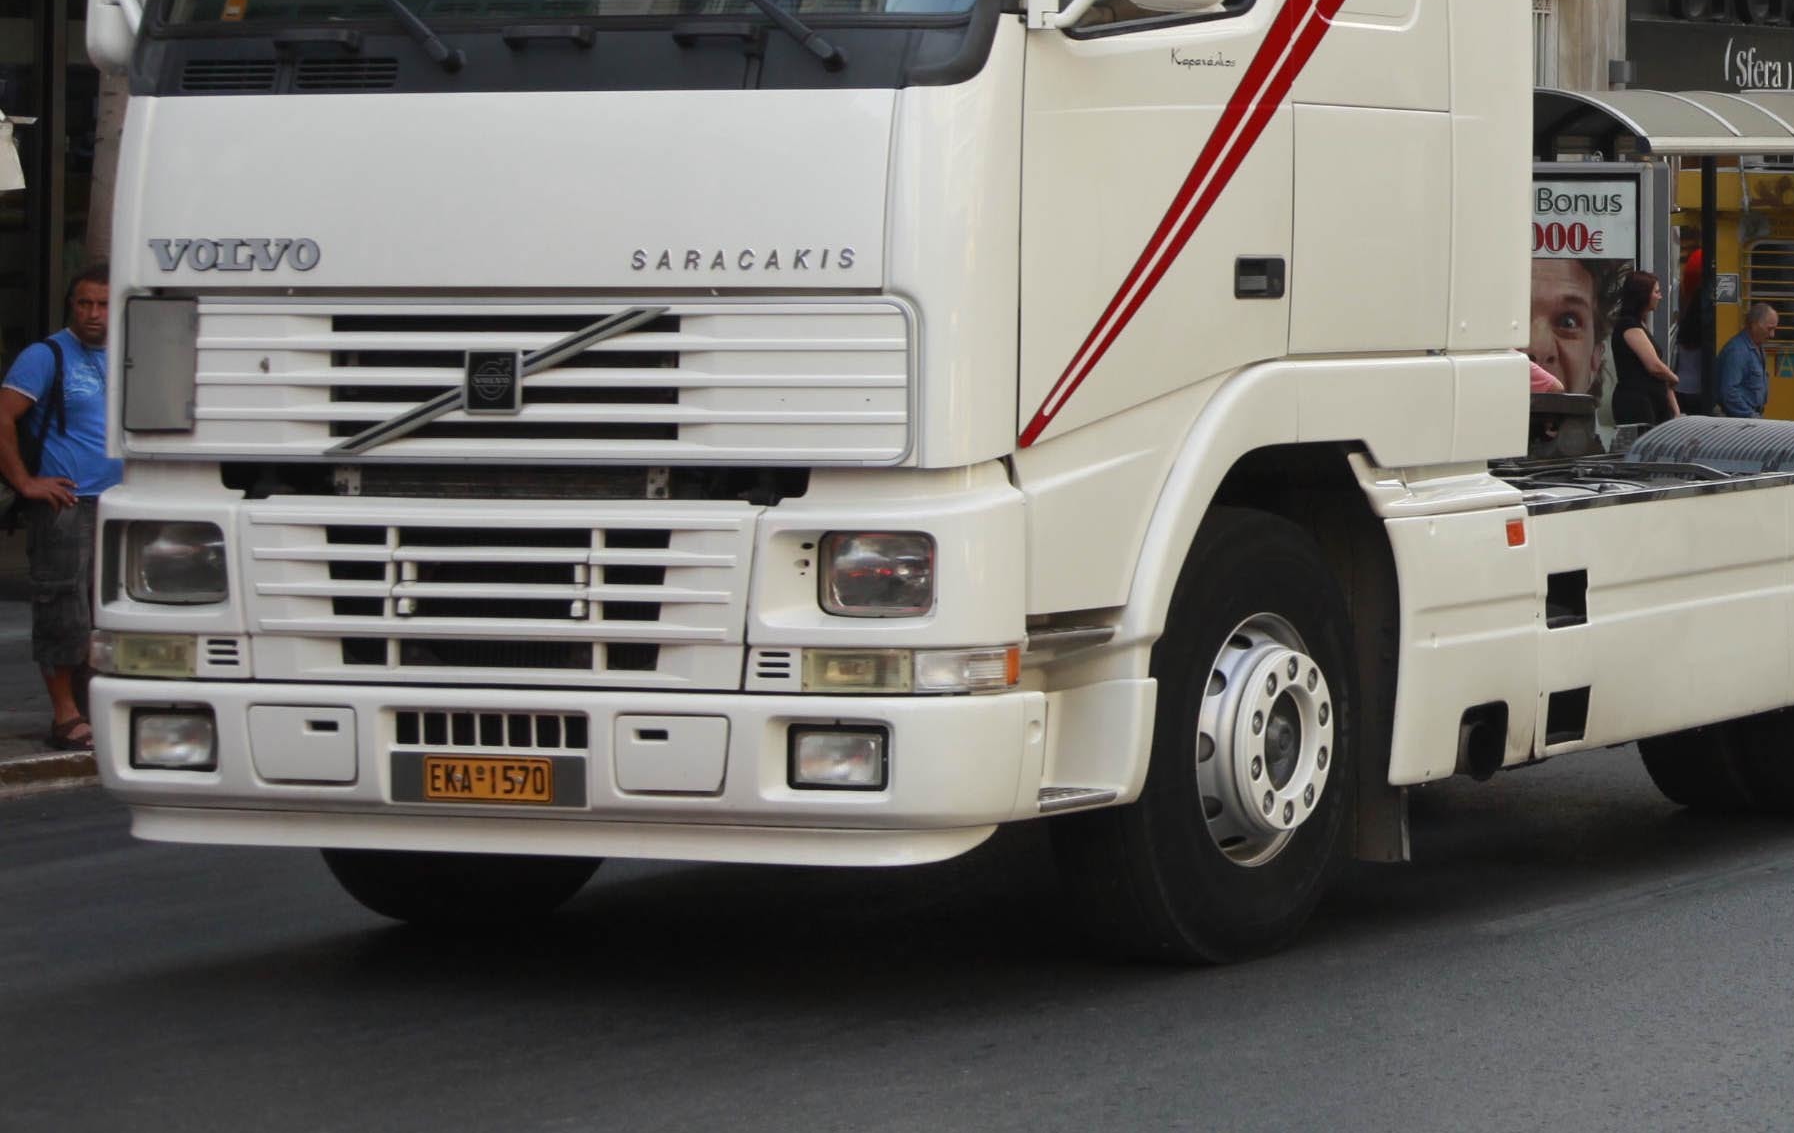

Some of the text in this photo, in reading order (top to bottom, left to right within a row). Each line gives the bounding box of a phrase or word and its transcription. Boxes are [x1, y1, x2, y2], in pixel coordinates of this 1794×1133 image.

[1536, 187, 1623, 214] Bonus
[148, 238, 321, 272] VOLVO
[630, 247, 856, 271] SARACAKIS
